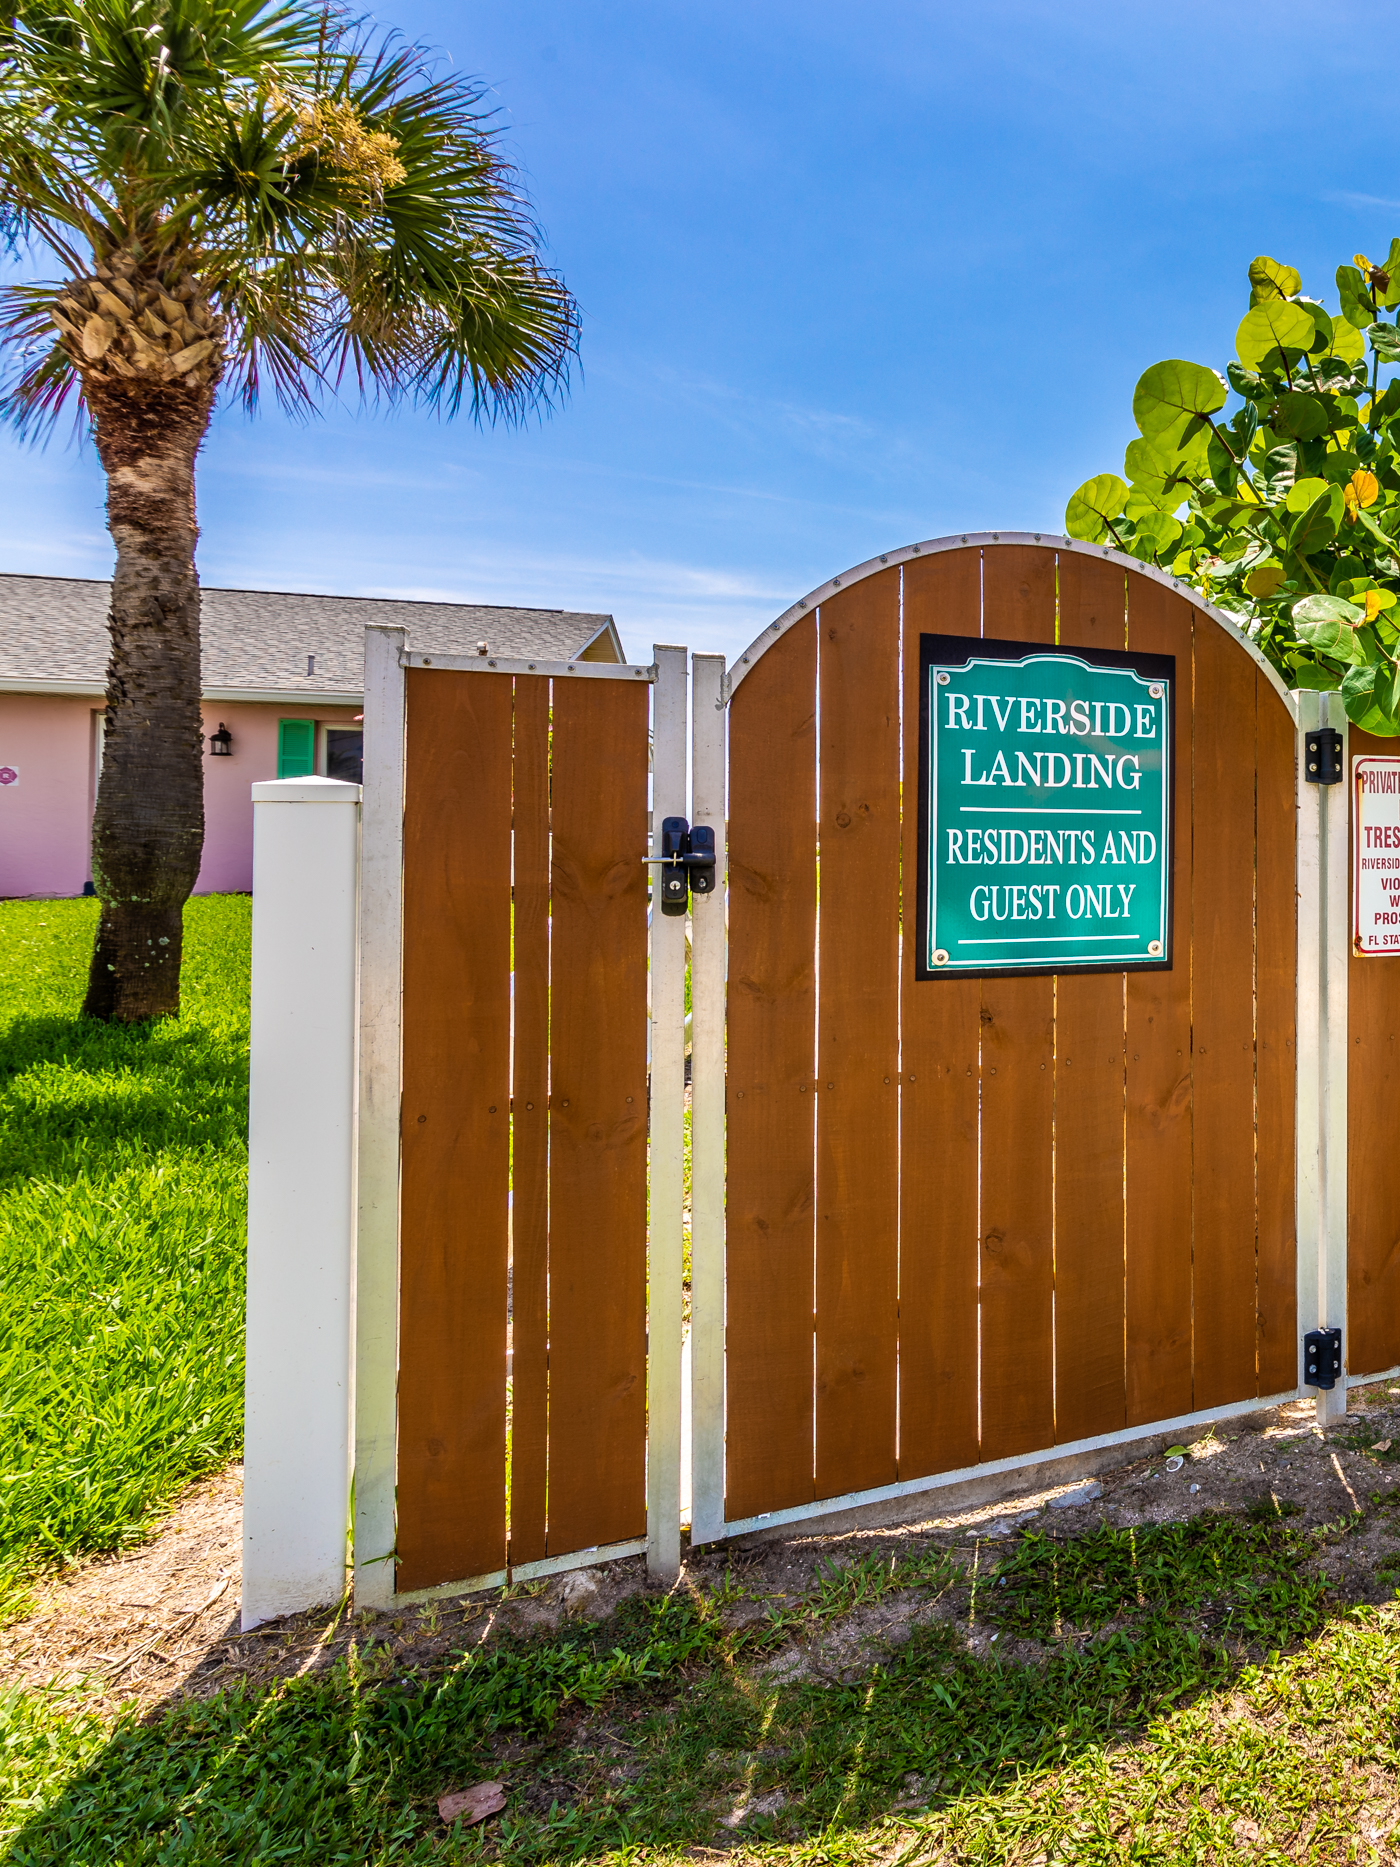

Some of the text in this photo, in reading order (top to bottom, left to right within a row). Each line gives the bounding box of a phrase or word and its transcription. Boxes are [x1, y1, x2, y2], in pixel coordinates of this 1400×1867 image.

[944, 692, 1156, 739] RIVERSIDE
[960, 748, 1143, 790] LANDING
[946, 828, 1157, 865] RESIDENTS AND
[969, 884, 1137, 922] GUEST ONLY
[1368, 935, 1380, 946] FL
